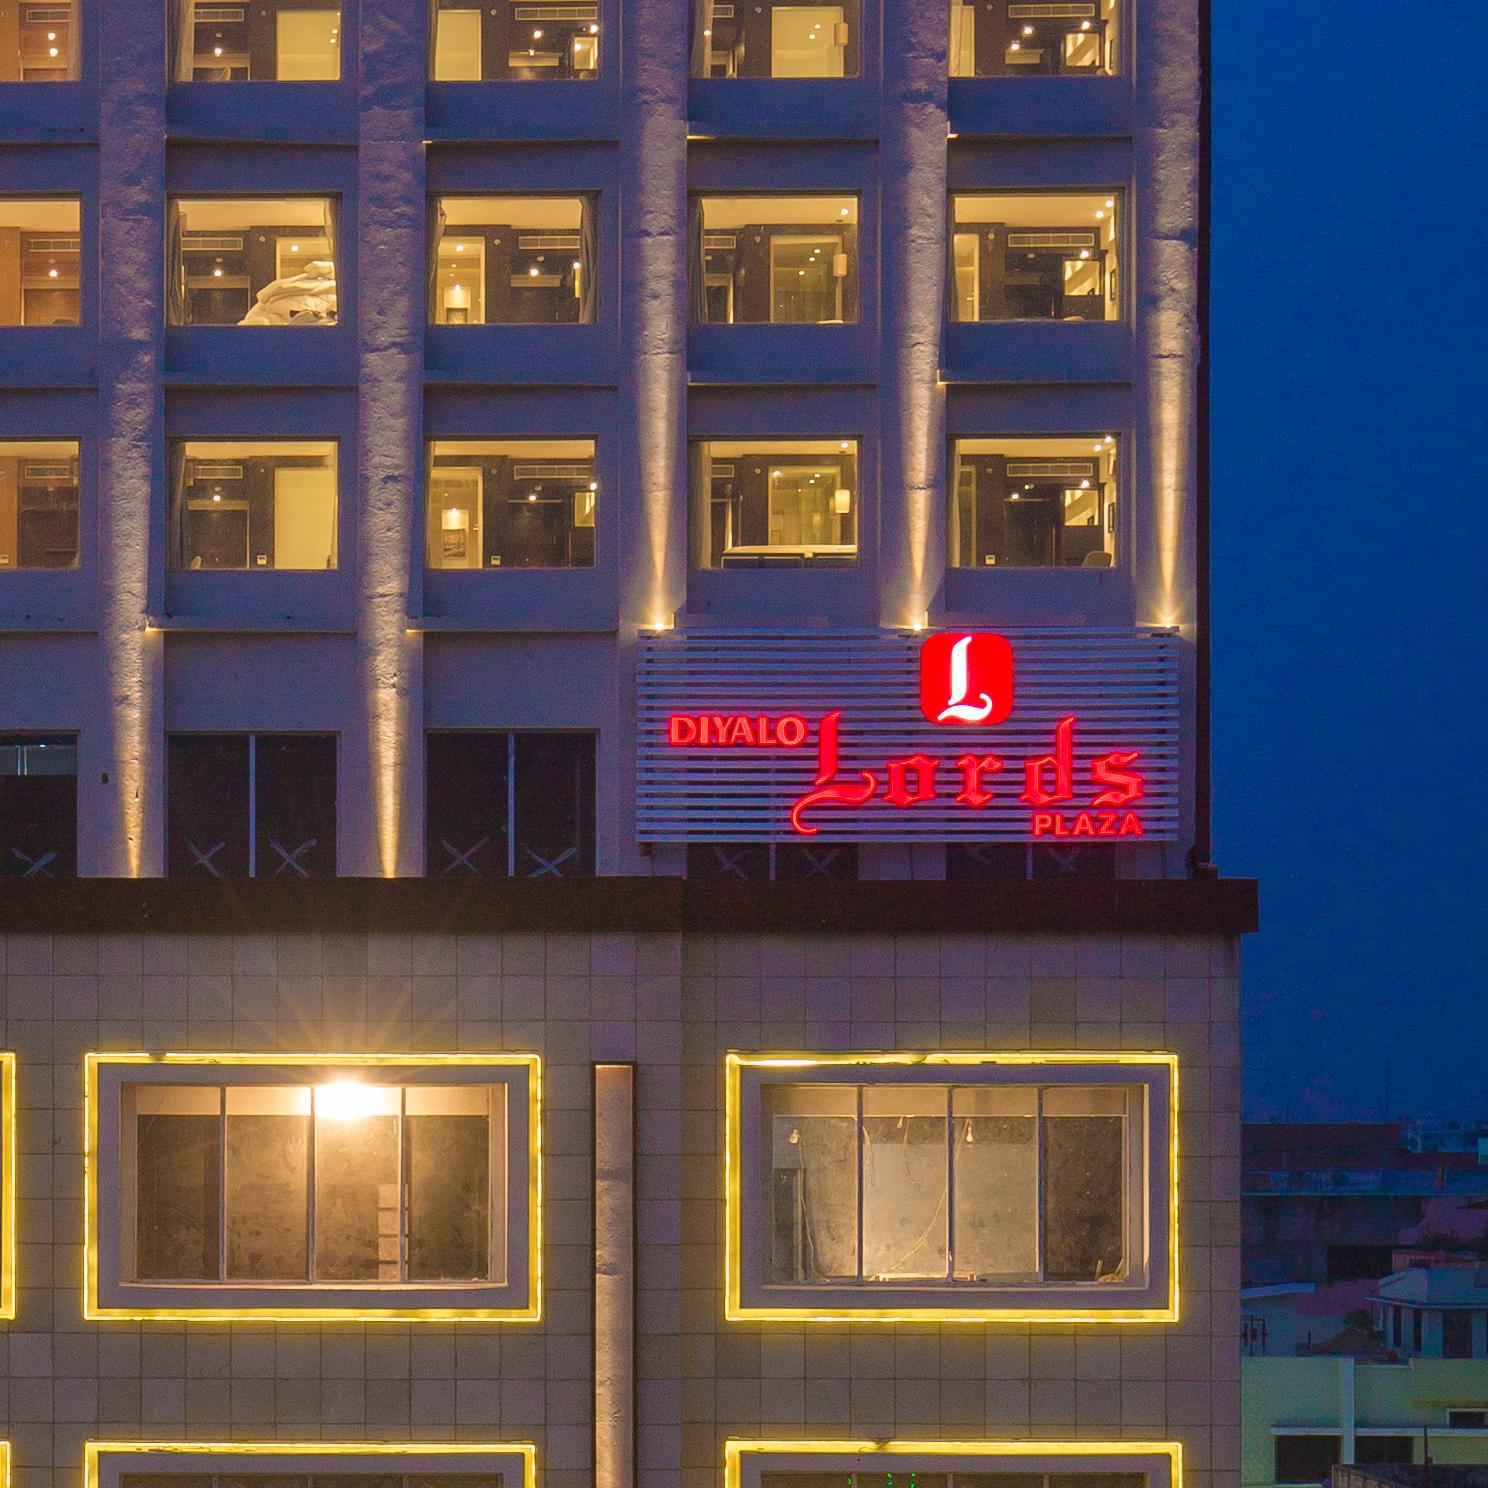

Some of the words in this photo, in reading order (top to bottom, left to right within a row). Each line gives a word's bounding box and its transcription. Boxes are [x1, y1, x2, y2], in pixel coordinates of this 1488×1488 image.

[936, 635, 994, 721] L
[669, 714, 807, 747] DIYALO
[790, 711, 1144, 834] Lords
[1033, 811, 1143, 836] PLAZA
